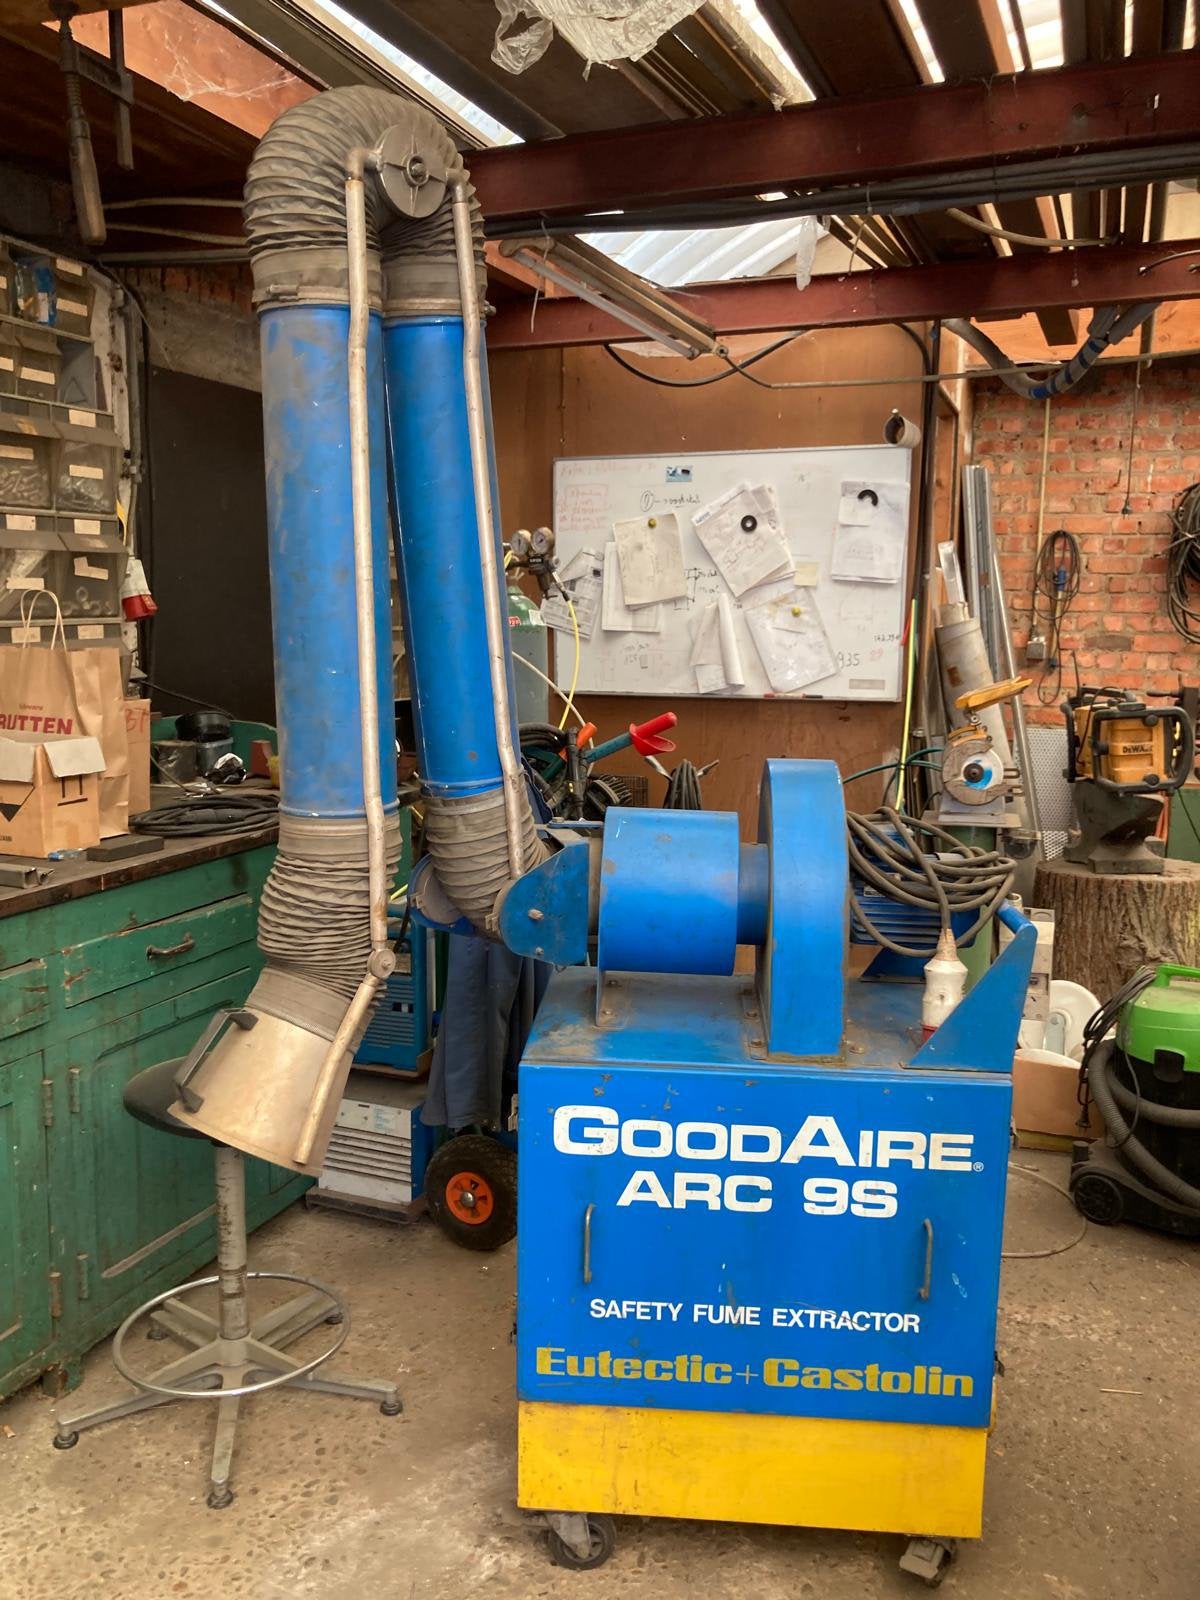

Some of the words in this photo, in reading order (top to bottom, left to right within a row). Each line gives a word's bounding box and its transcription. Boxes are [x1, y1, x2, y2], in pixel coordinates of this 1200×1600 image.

[617, 1170, 773, 1213] ARC
[803, 1177, 898, 1219] 9S
[590, 1298, 684, 1322] SAFETY
[693, 1304, 761, 1326] FUME
[772, 1308, 921, 1333] EXTRACTOR
